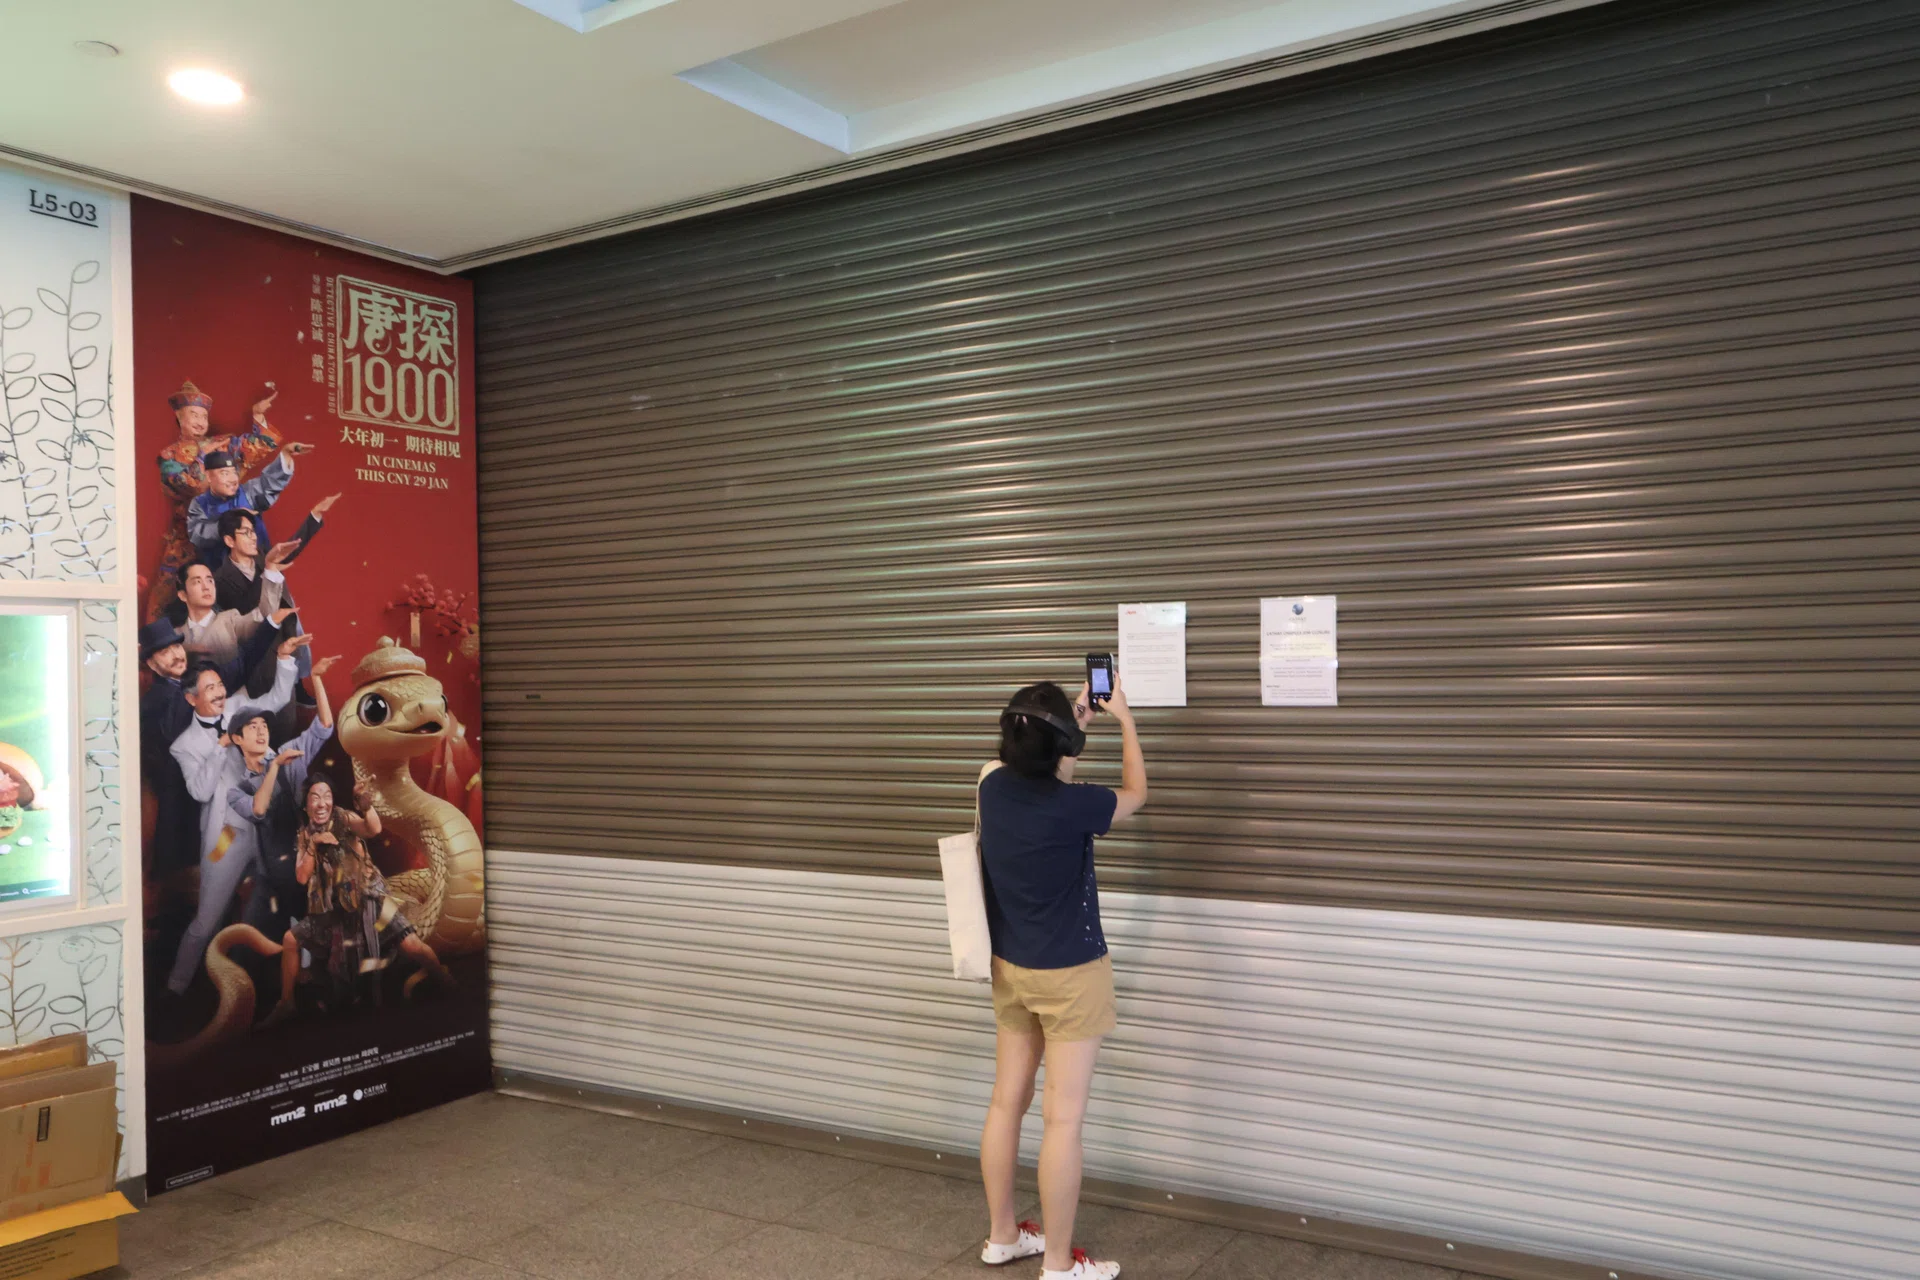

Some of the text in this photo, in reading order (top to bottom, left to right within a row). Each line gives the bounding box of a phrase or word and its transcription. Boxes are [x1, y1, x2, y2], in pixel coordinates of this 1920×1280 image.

[29, 188, 97, 222] L5-03
[326, 276, 335, 328] DETECTIVE
[327, 332, 336, 388] CHINATOWN
[344, 353, 454, 428] 1900
[340, 426, 461, 458] 大年初一 期待相见
[355, 468, 449, 490] THIS CNY 29 JAN
[366, 454, 436, 473] IN CINEMAS
[270, 1106, 306, 1126] mm2
[314, 1093, 348, 1113] mm2
